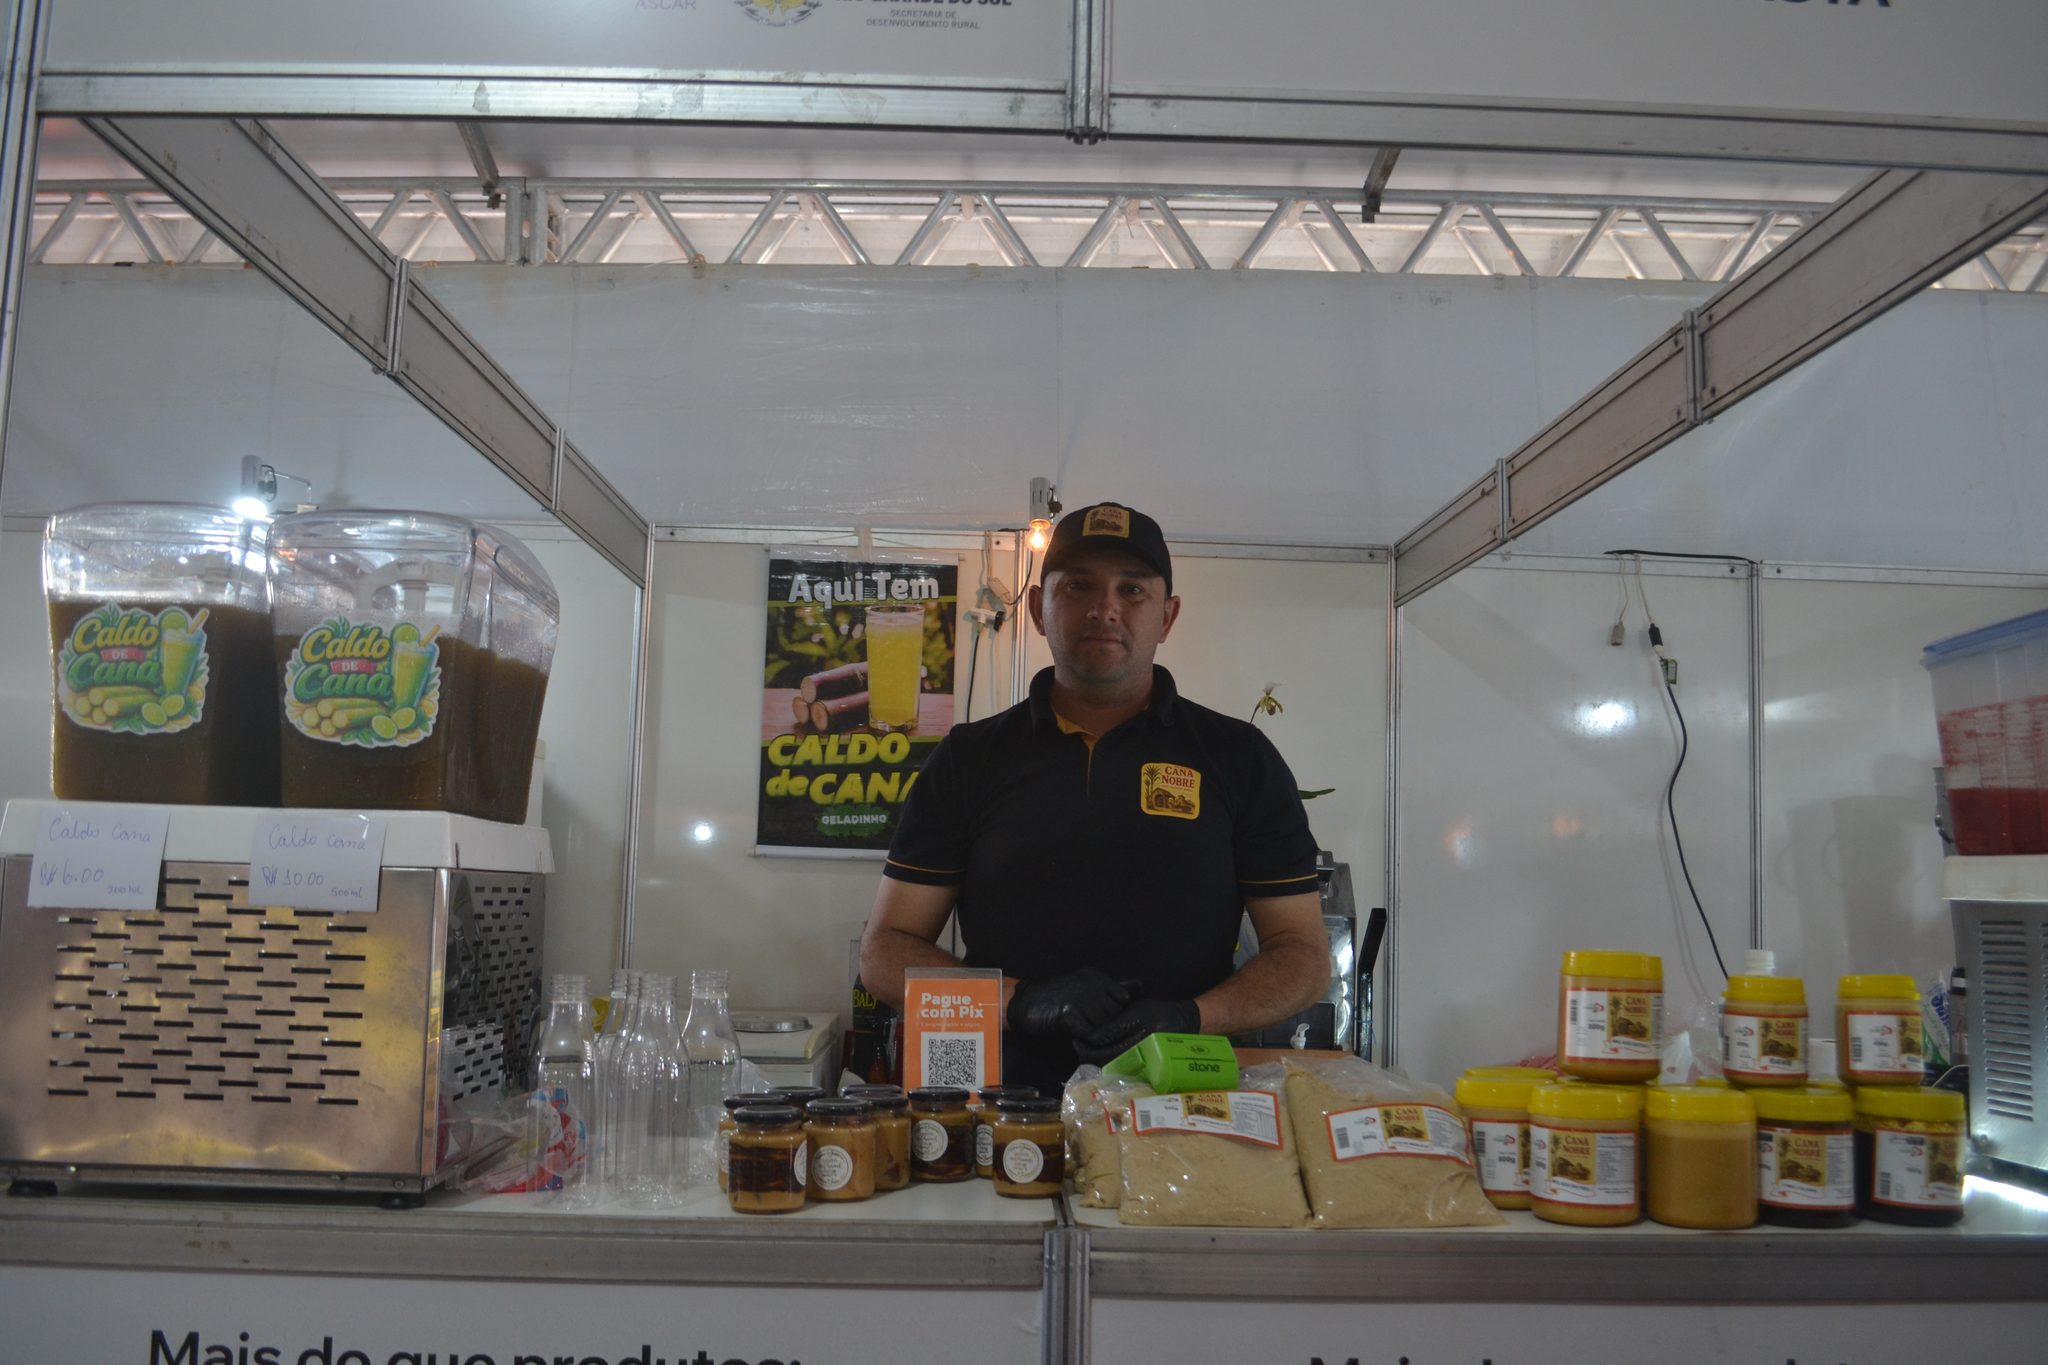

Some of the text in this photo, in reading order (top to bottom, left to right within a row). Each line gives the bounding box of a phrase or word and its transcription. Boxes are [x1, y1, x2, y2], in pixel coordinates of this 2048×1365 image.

[890, 9, 957, 19] SECRETARIA DE
[866, 18, 980, 30] DESENVOLVIMENTO RURAL
[787, 571, 939, 610] Aqui Tem
[73, 615, 160, 653] Caldo
[302, 626, 391, 663] Caldo
[112, 651, 129, 661] DE
[67, 653, 161, 690] Cana
[341, 661, 359, 671] DE
[296, 664, 391, 701] Cana
[768, 733, 910, 766] CALDO
[1164, 766, 1194, 778] CANA
[766, 768, 810, 798] de
[1161, 775, 1195, 788] NOBRE
[821, 814, 888, 825] GELADINHO
[49, 817, 100, 841] Caldo
[269, 824, 317, 850] Caldo
[62, 858, 104, 885] 6.00
[921, 992, 972, 1008] Pague
[920, 1006, 984, 1018] com Pix
[1188, 1061, 1220, 1072] stone
[1565, 1135, 1589, 1146] CANA
[1795, 1137, 1819, 1147] CANA
[1563, 1144, 1590, 1155] NOBRE
[150, 1330, 281, 1365] Mais
